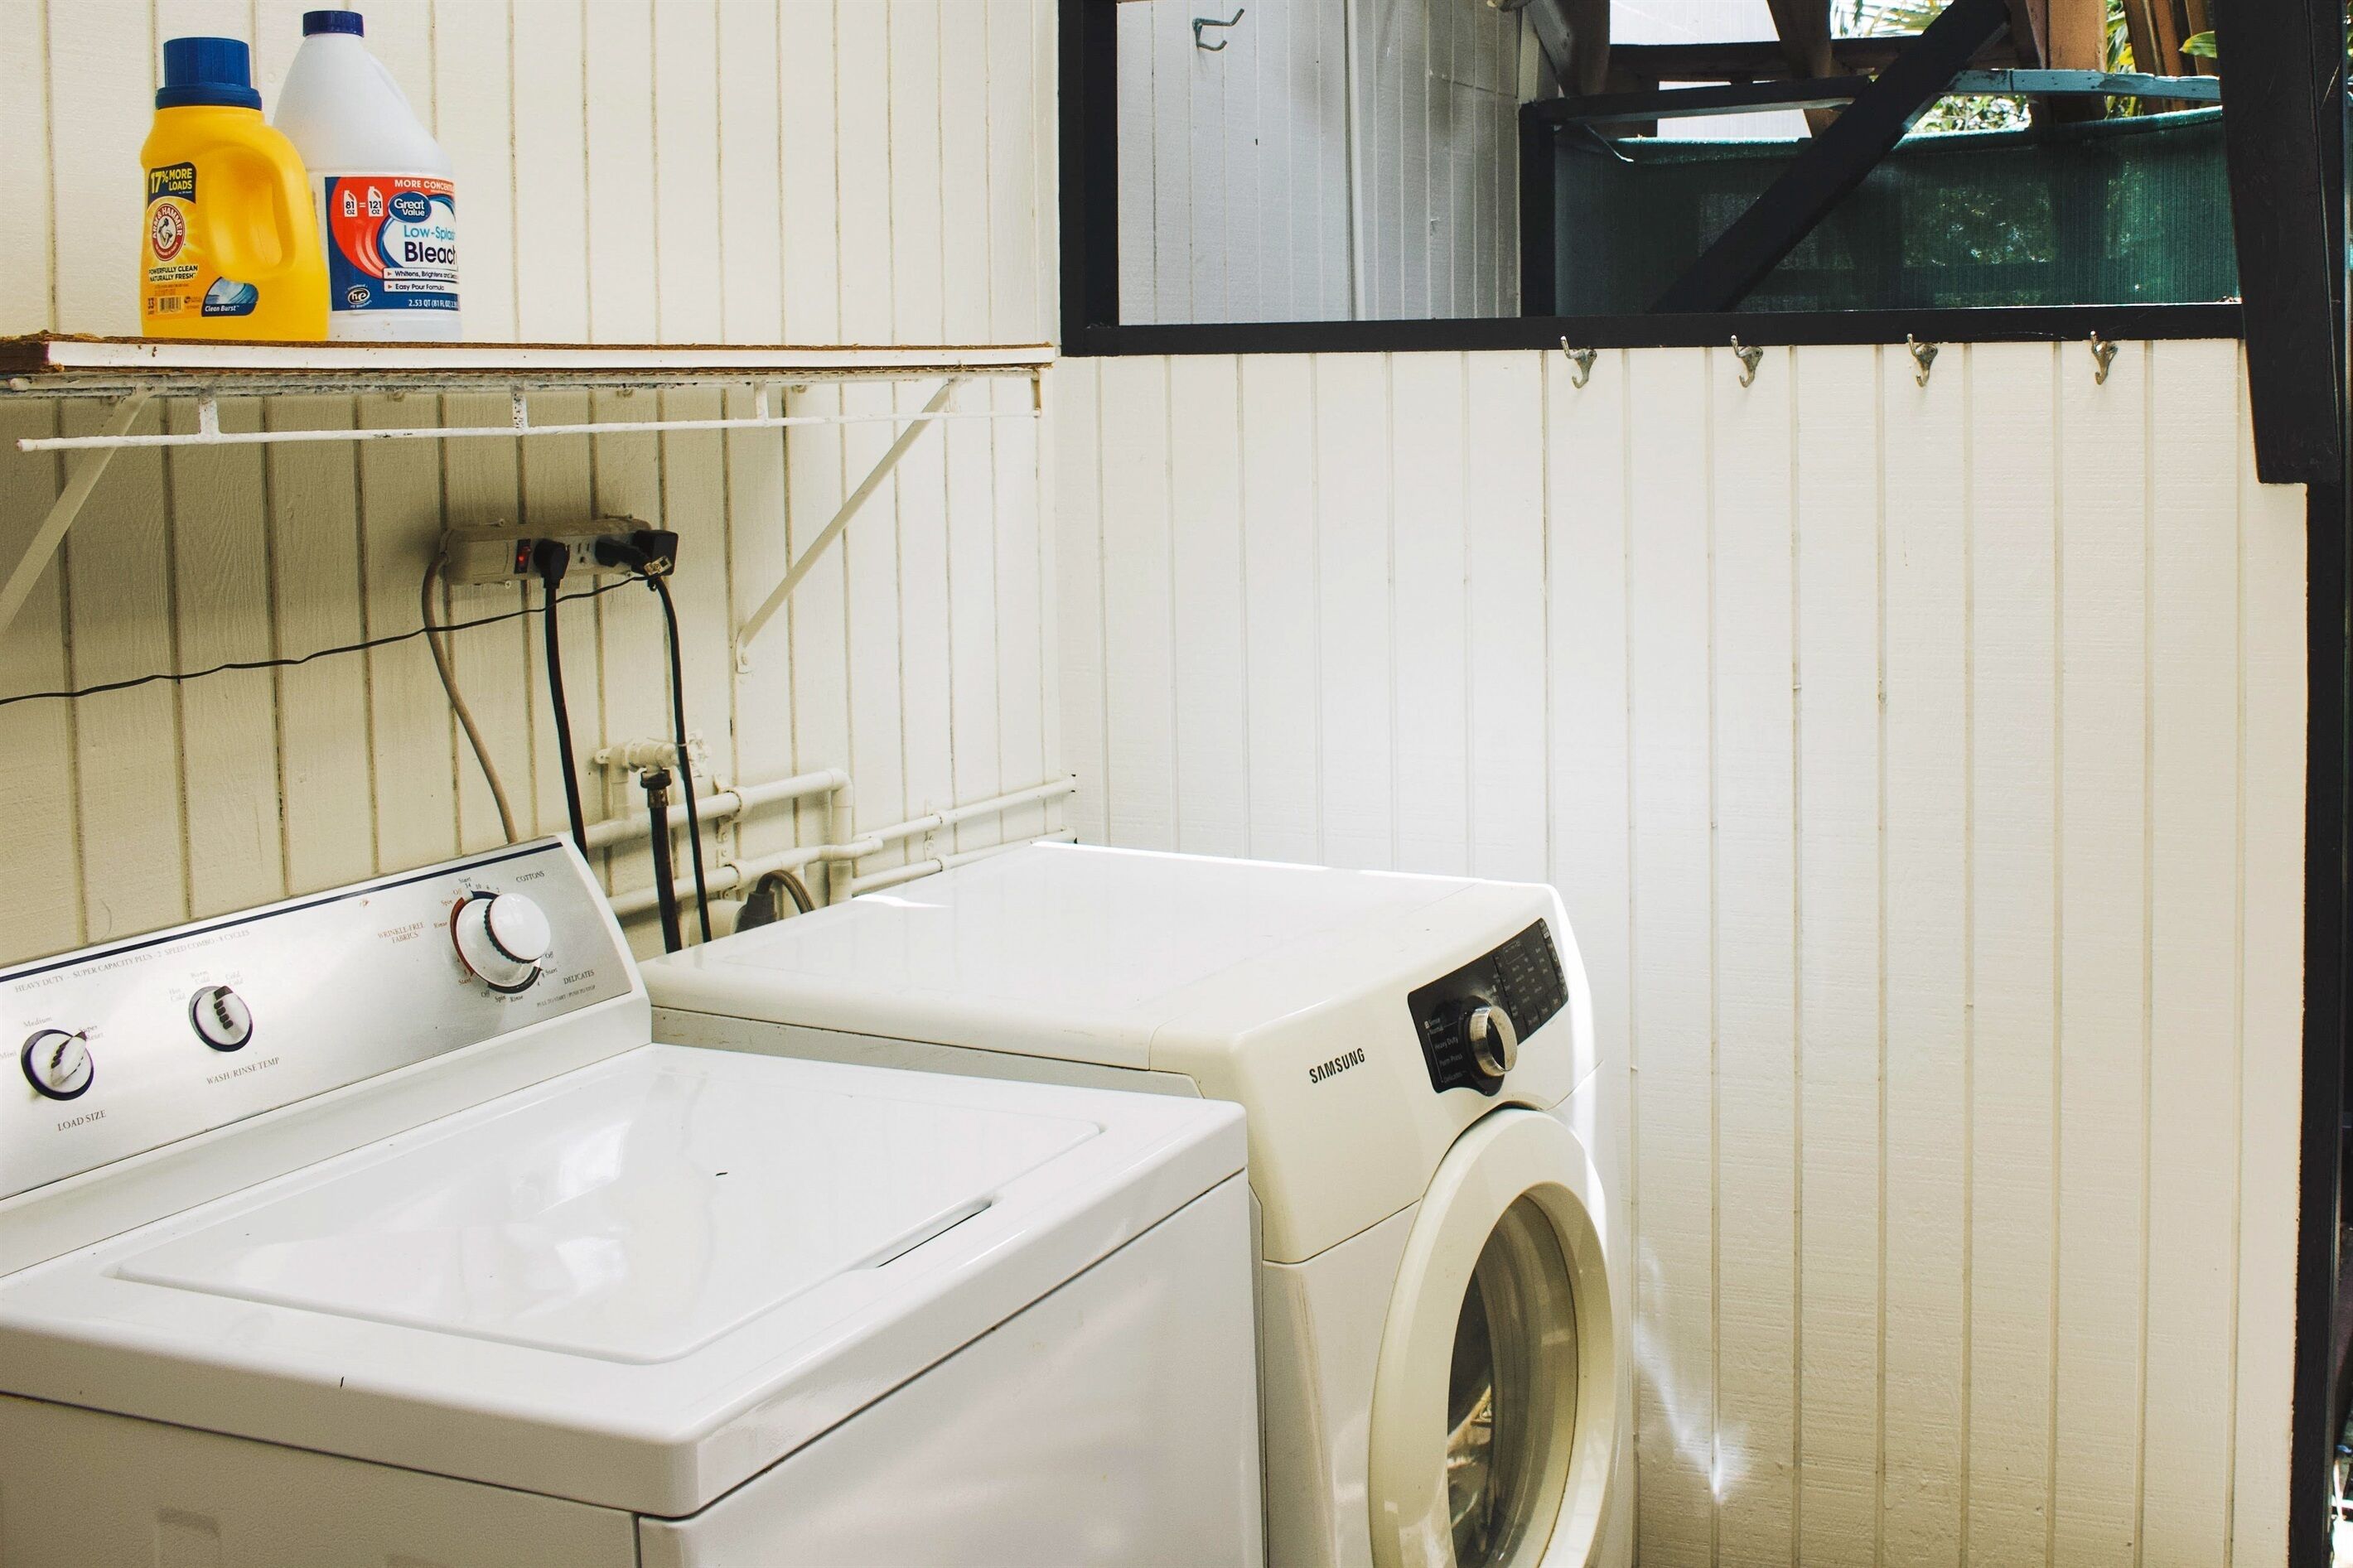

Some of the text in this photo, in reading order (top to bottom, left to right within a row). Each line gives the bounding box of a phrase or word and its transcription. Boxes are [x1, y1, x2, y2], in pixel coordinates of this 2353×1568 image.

[168, 167, 193, 181] MORE
[151, 171, 168, 194] 17%
[168, 180, 193, 191] LOADS
[394, 179, 421, 188] MORE
[345, 200, 355, 209] 81
[369, 200, 382, 209] 121
[394, 198, 425, 210] Great
[402, 209, 425, 217] Value
[162, 206, 183, 236] HAMMER
[177, 264, 199, 273] CLEAN
[395, 283, 410, 292] Easy
[205, 305, 220, 313] Clean
[408, 299, 423, 307] 2.53
[423, 299, 431, 307] QT
[515, 871, 545, 883] COTTONS
[391, 931, 419, 943] FABRICS
[14, 980, 41, 993] HEAVY
[42, 974, 65, 987] DUTY
[73, 966, 98, 978] SUPER
[99, 957, 133, 972] CAPACITY
[134, 953, 153, 963] PLUS
[164, 944, 186, 957] SPEED
[224, 929, 250, 942] CYCLES
[563, 969, 595, 985] DELICATES
[23, 1016, 53, 1027] Medium
[258, 1055, 281, 1071] TEMP
[1308, 1047, 1365, 1084] SAMSUNG
[57, 1109, 107, 1132] LOAD SIZE
